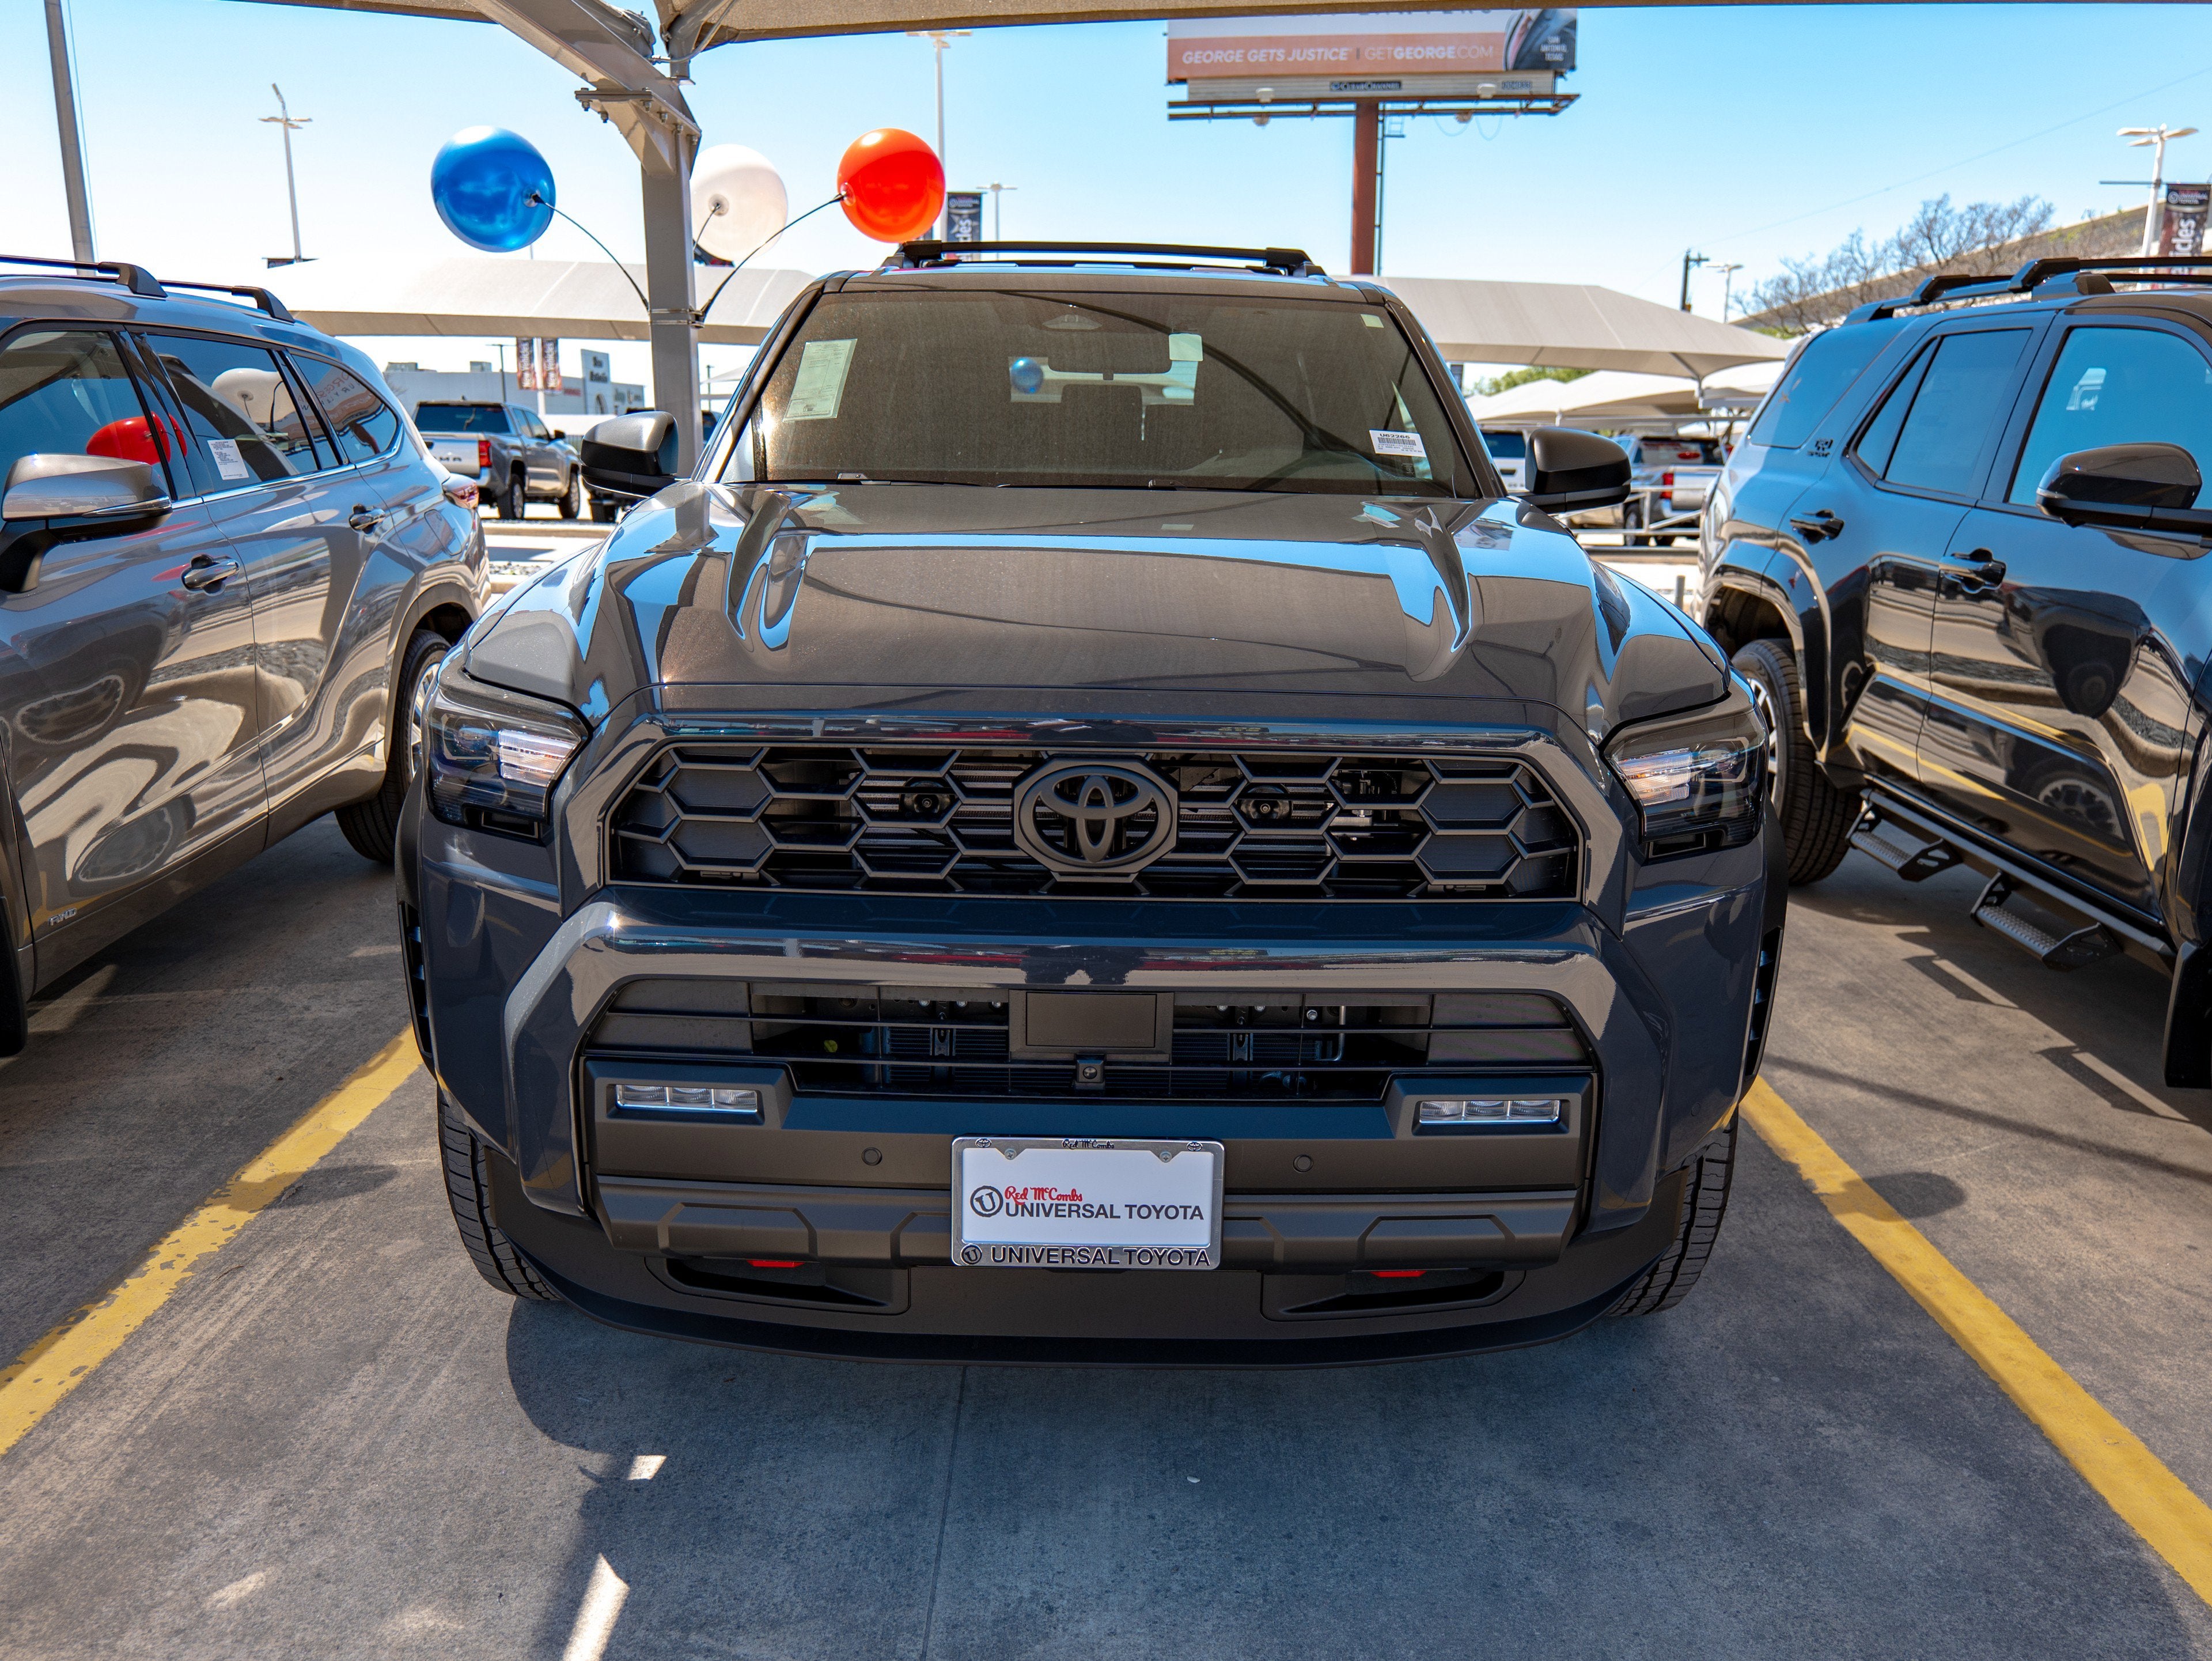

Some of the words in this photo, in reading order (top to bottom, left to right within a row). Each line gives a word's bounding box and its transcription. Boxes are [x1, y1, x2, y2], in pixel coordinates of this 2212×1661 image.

[1182, 50, 1245, 64] GEORGE
[1247, 48, 1286, 62] GETS
[1287, 47, 1349, 61] JUSTICE
[1062, 1139, 1078, 1149] Red
[1080, 1139, 1115, 1149] McCombs
[1005, 1186, 1028, 1205] Red
[1031, 1187, 1082, 1202] McCombs
[1005, 1203, 1120, 1219] UNIVERSAL
[1124, 1204, 1205, 1220] TOYOTA
[991, 1246, 1120, 1265] UNIVERSAL
[1123, 1248, 1210, 1266] TOYOTA
